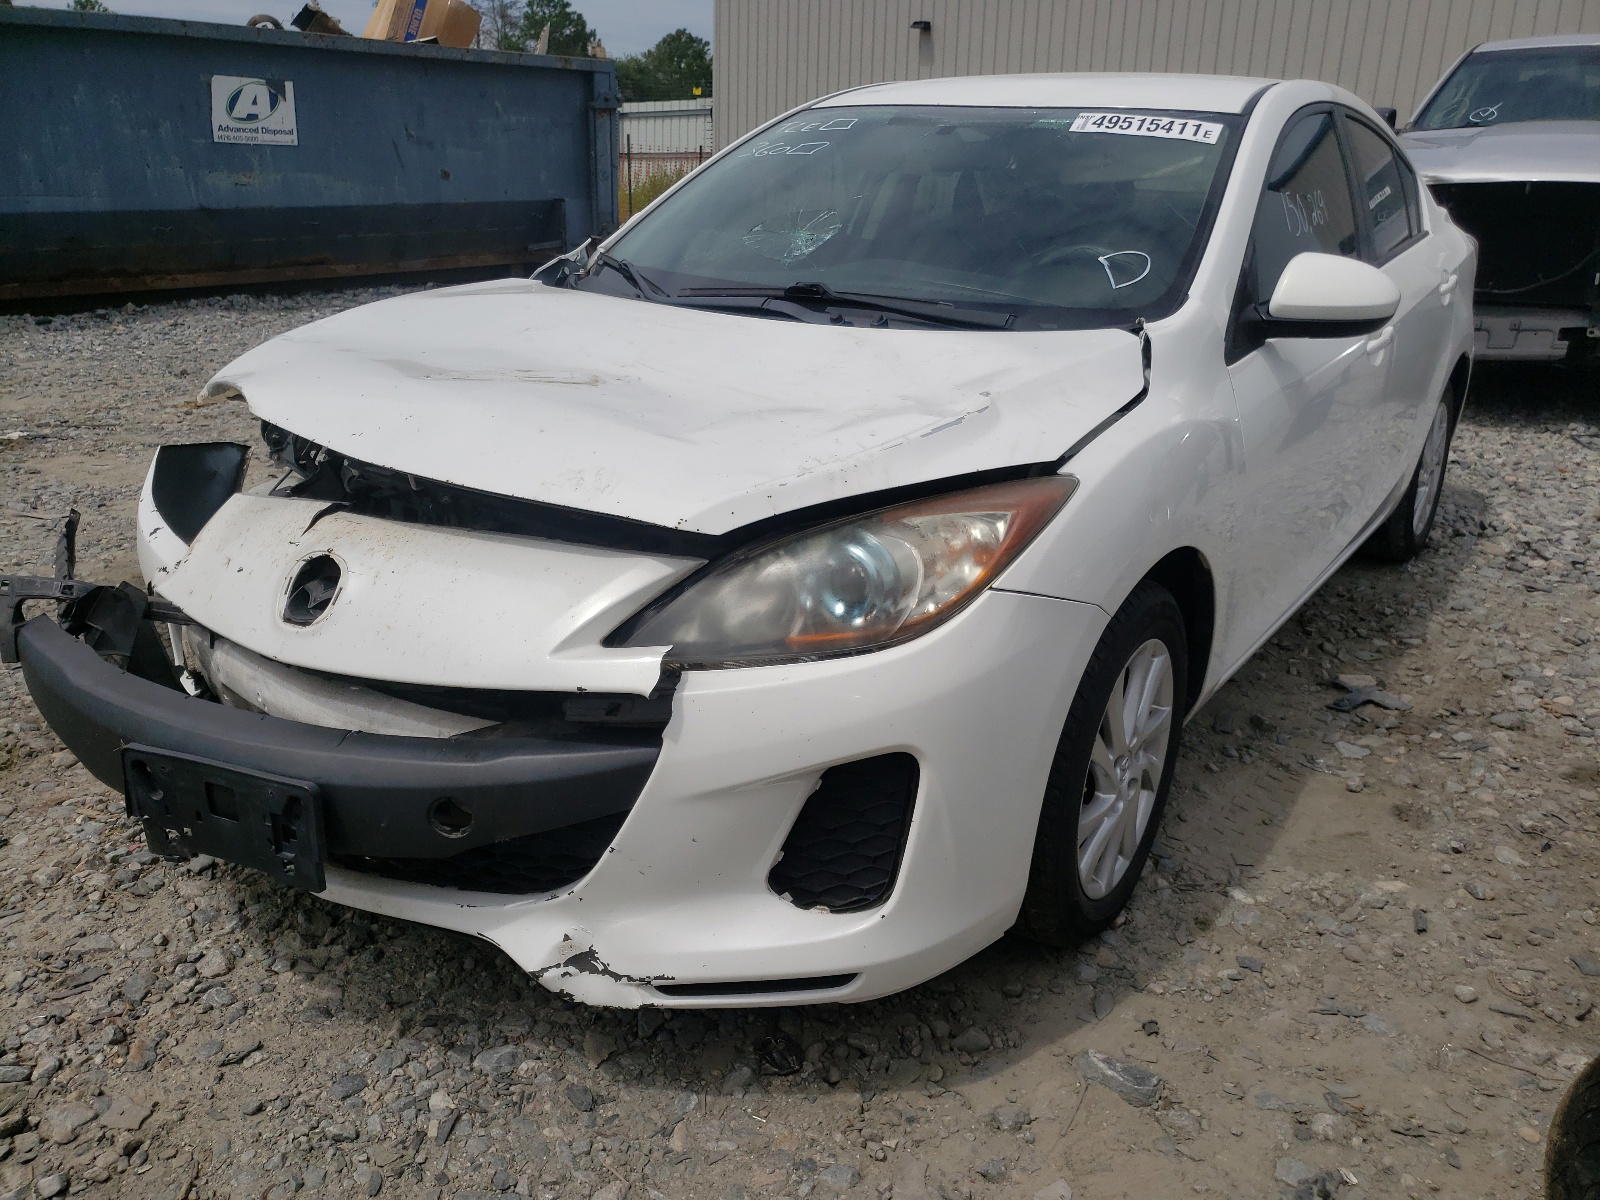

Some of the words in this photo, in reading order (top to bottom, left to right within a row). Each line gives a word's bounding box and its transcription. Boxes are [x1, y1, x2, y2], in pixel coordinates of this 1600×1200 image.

[217, 124, 259, 134] Advanced
[261, 126, 294, 136] Disposal
[1091, 114, 1202, 137] 49515411
[1203, 130, 1213, 139] E
